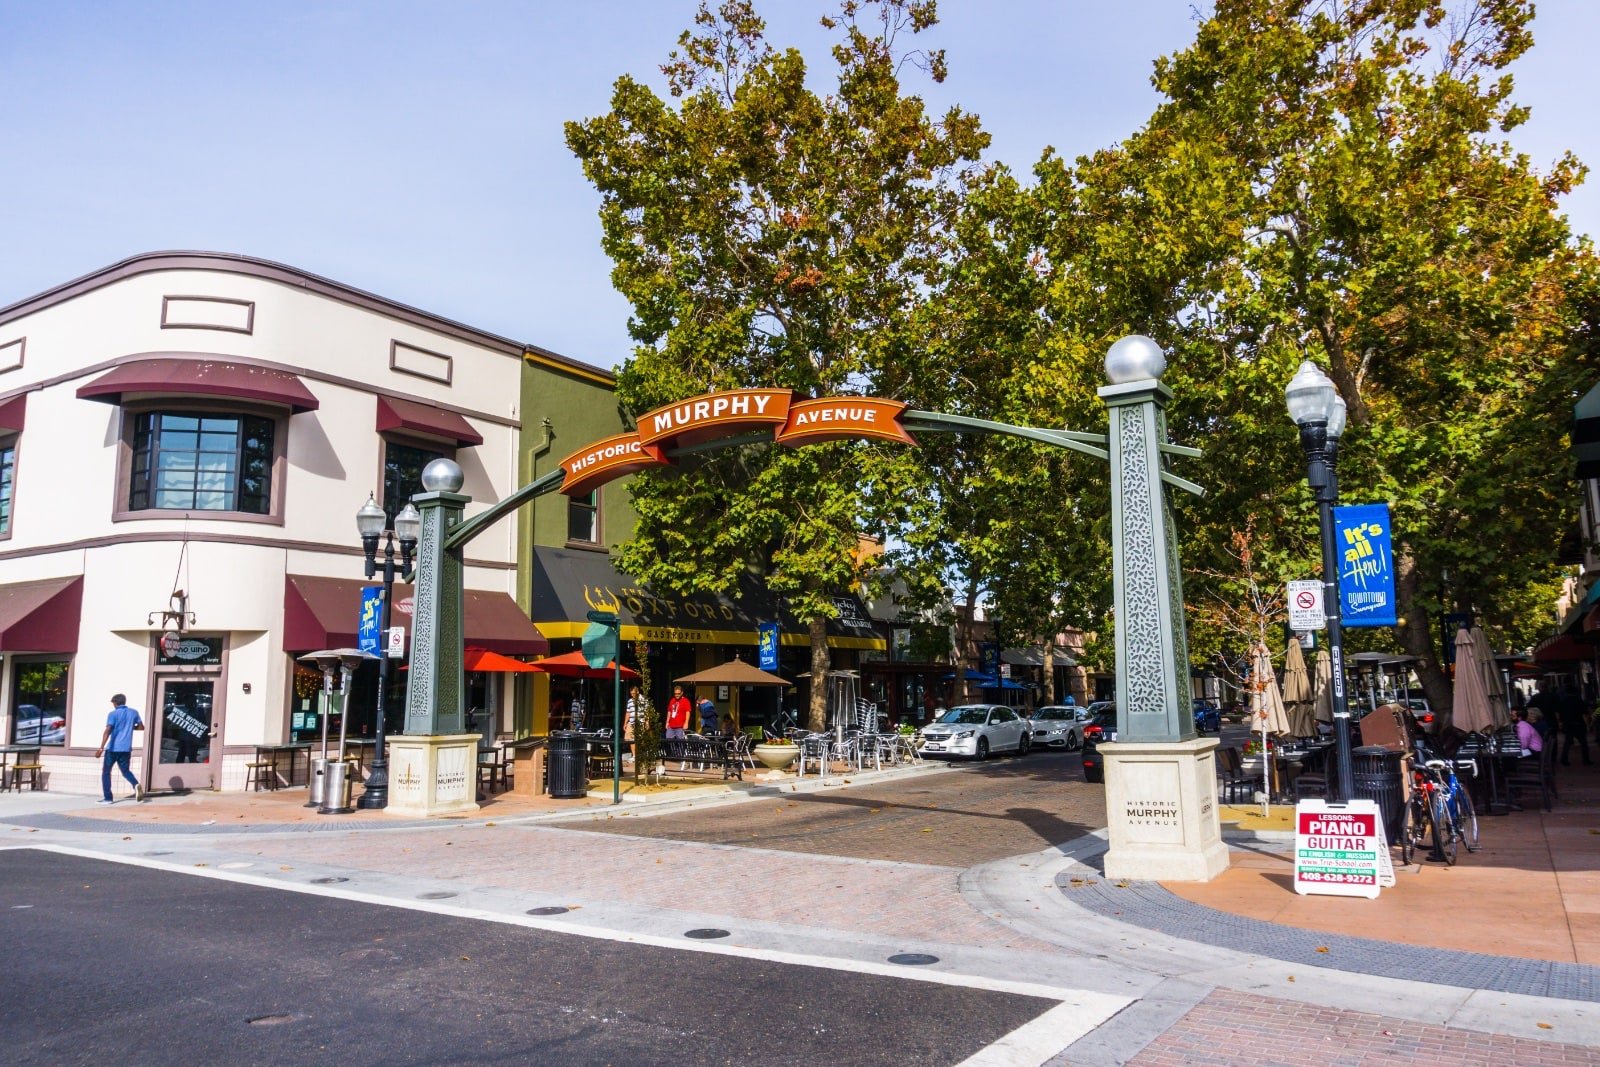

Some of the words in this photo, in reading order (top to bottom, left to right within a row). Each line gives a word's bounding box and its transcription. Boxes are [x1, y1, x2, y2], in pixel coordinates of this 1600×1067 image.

[653, 395, 772, 433] MURPHY
[796, 408, 877, 426] AVENUE
[571, 441, 642, 474] HISTORIC
[1343, 522, 1384, 545] It's
[1344, 539, 1374, 562] all
[1343, 543, 1389, 591] Here!
[621, 587, 645, 597] THE
[627, 597, 734, 620] OXFORD
[646, 630, 702, 640] GASTROPUB
[167, 712, 204, 738] ATTITUDE
[438, 777, 465, 785] MURPHY
[1127, 809, 1177, 818] MURPHY
[1318, 814, 1355, 822] LESSONS:
[1309, 821, 1366, 836] PIANO
[1308, 837, 1366, 850] GUITAR
[1301, 872, 1373, 884] 408-628-9272
